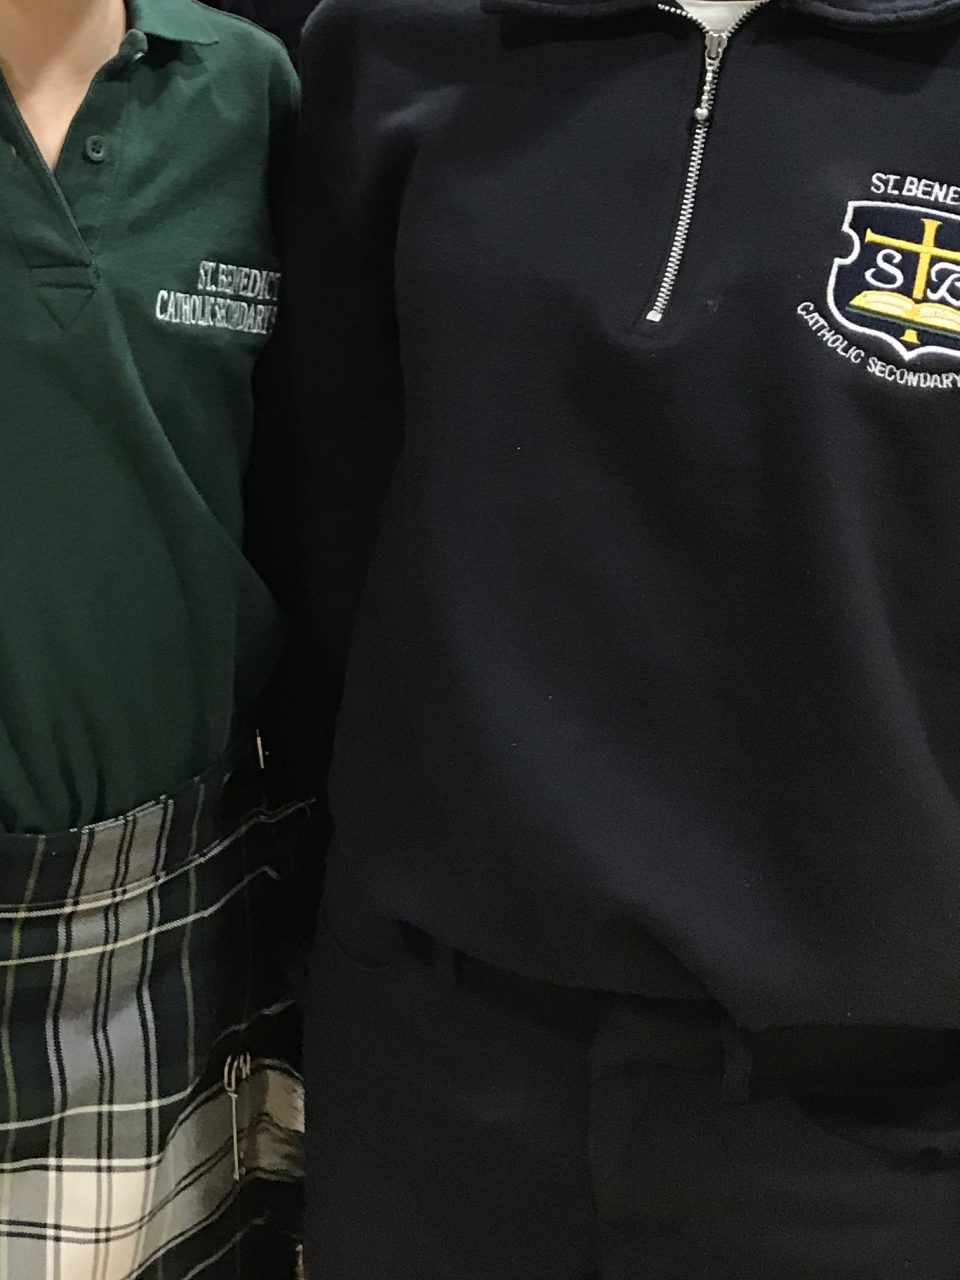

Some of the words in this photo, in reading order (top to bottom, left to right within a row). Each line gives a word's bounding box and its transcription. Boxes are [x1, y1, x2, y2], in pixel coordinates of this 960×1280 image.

[902, 175, 960, 205] BENE
[217, 262, 282, 301] BENEDICT
[155, 289, 215, 326] CATHOLIC
[796, 301, 865, 364] CATHOLIC
